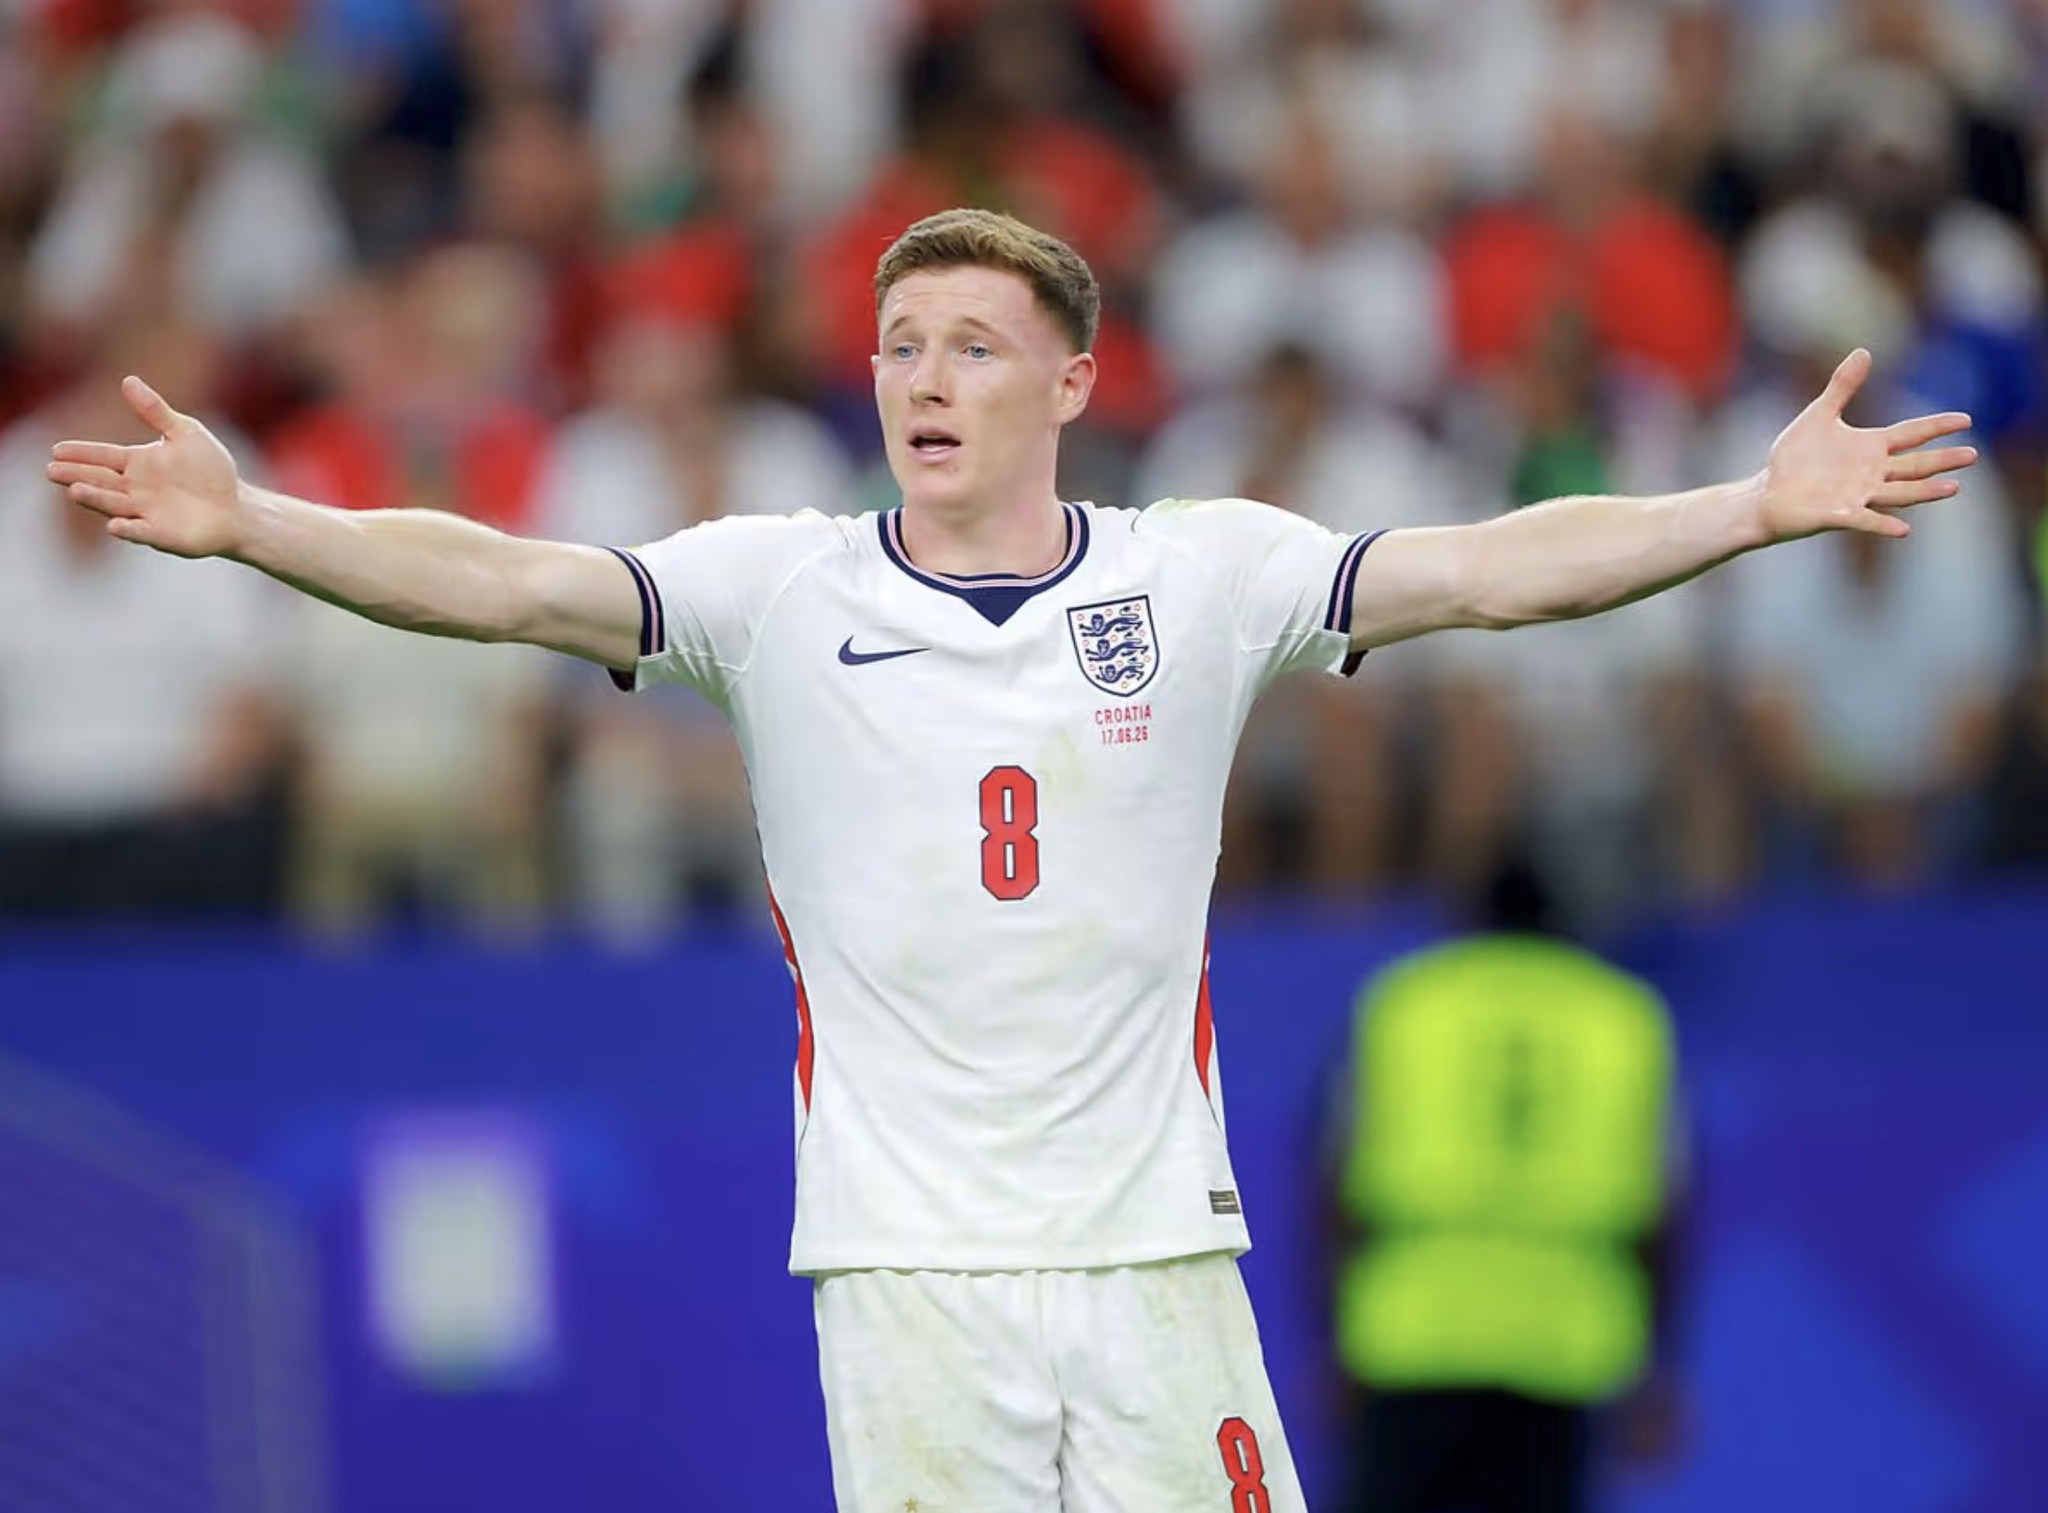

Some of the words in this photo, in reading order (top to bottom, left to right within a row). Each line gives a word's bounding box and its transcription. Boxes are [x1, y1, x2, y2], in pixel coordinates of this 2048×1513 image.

[1095, 704, 1152, 725] CROATIA
[1101, 725, 1148, 745] 17.06.26
[979, 765, 1039, 900] 8
[1216, 1416, 1271, 1513] 8
